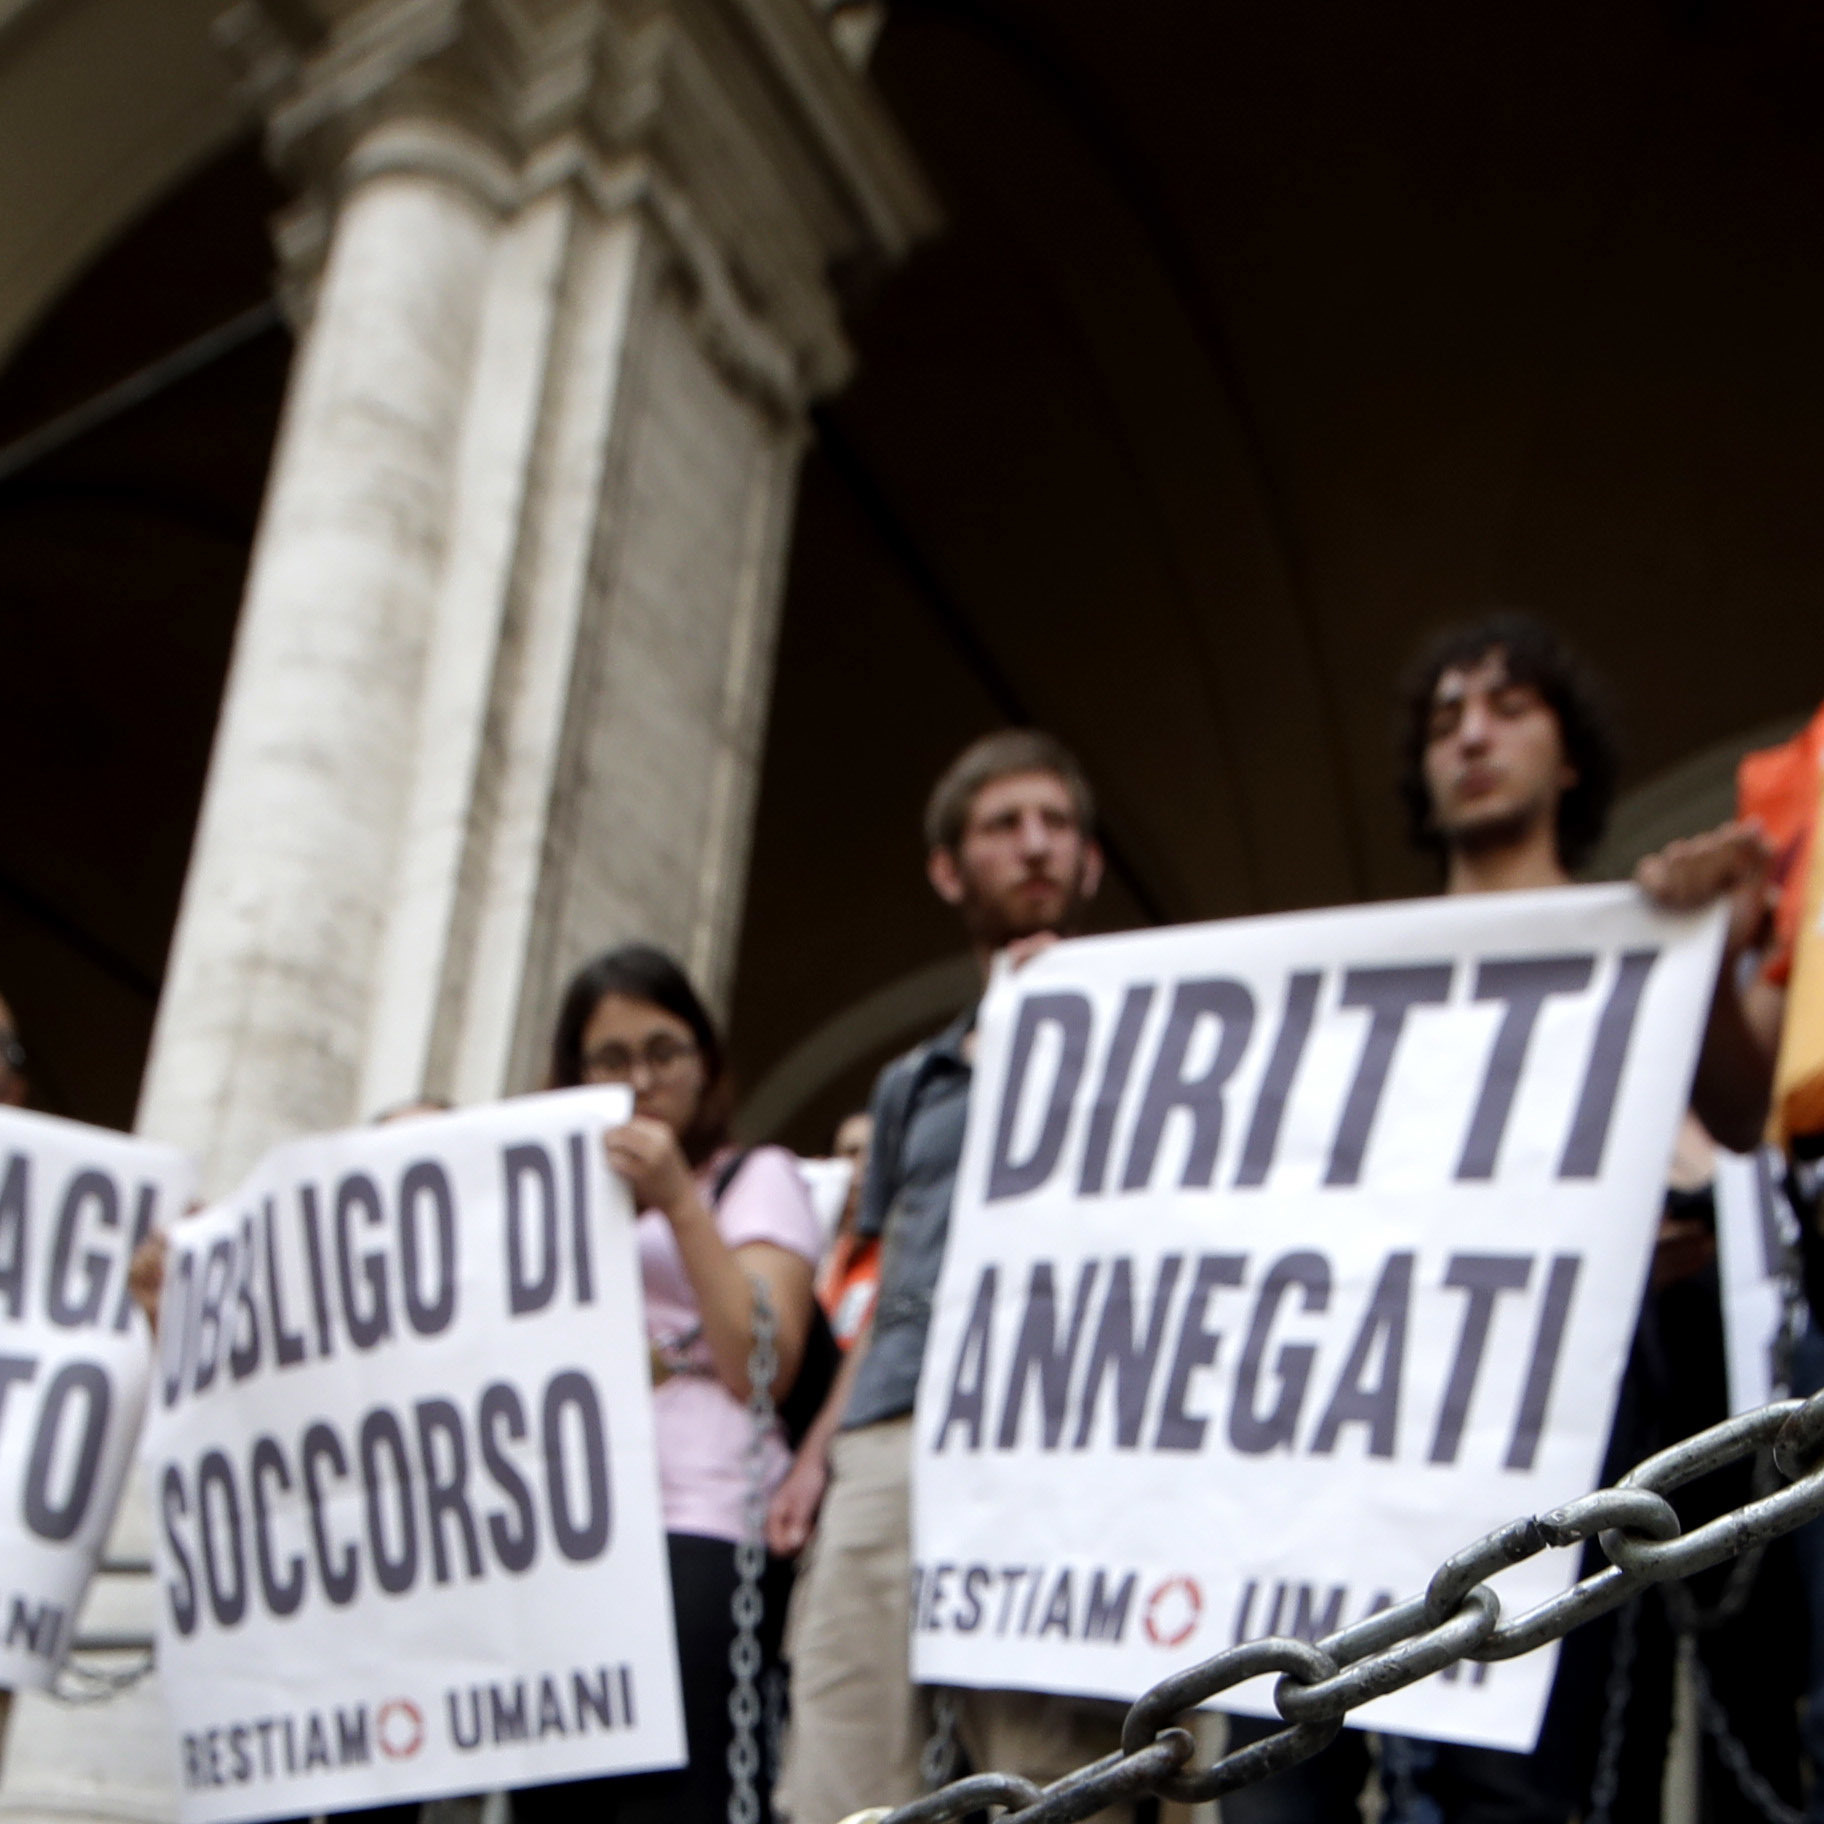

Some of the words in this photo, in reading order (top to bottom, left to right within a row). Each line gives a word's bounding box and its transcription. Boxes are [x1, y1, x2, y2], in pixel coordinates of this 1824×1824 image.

[983, 948, 1661, 1206] DIRITTI
[501, 1132, 597, 1317] DI
[933, 1247, 1585, 1474] ANNEGATI
[160, 1369, 614, 1639] SOCCORSO
[446, 1664, 638, 1753] UMANI
